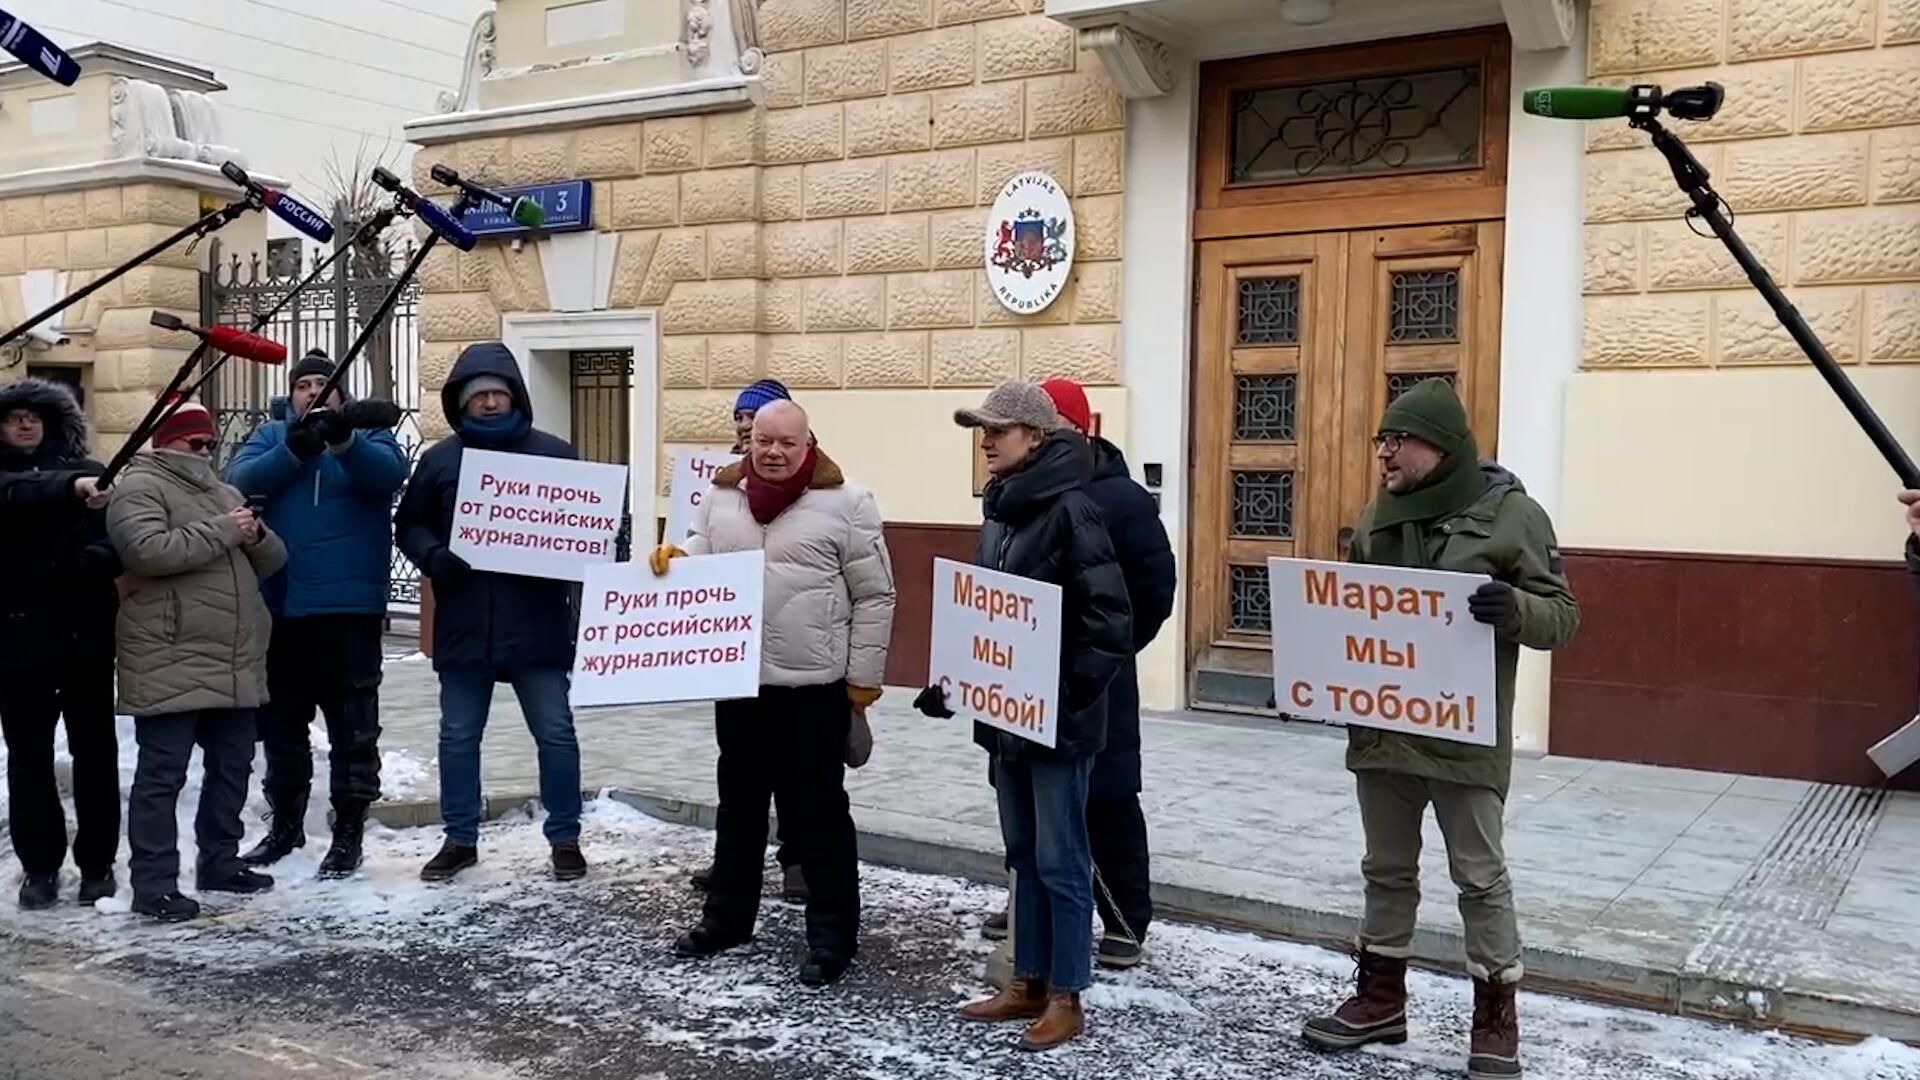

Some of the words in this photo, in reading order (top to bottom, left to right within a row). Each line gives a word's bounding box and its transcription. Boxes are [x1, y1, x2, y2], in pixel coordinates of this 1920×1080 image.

[556, 190, 568, 212] 3
[1005, 176, 1056, 198] LATVIJAS
[278, 196, 325, 231] РОССИЯ
[999, 282, 1058, 309] REPUBLIKA
[480, 473, 530, 498] Руки
[536, 483, 602, 504] прочь
[460, 501, 484, 516] от
[489, 503, 615, 531] российских
[458, 526, 609, 556] журналистов!
[604, 590, 658, 615] Руки
[664, 586, 736, 610] прочь
[953, 571, 1037, 631] Марат,
[1304, 568, 1454, 626] Марат,
[583, 625, 608, 642] от
[614, 613, 753, 644] российских
[581, 640, 747, 676] журналистов!
[972, 635, 1013, 671] мы
[1345, 635, 1416, 669] мы
[939, 675, 951, 700] с
[959, 681, 1045, 733] тобой!
[1290, 680, 1314, 708] с
[1325, 684, 1476, 733] тобой!
